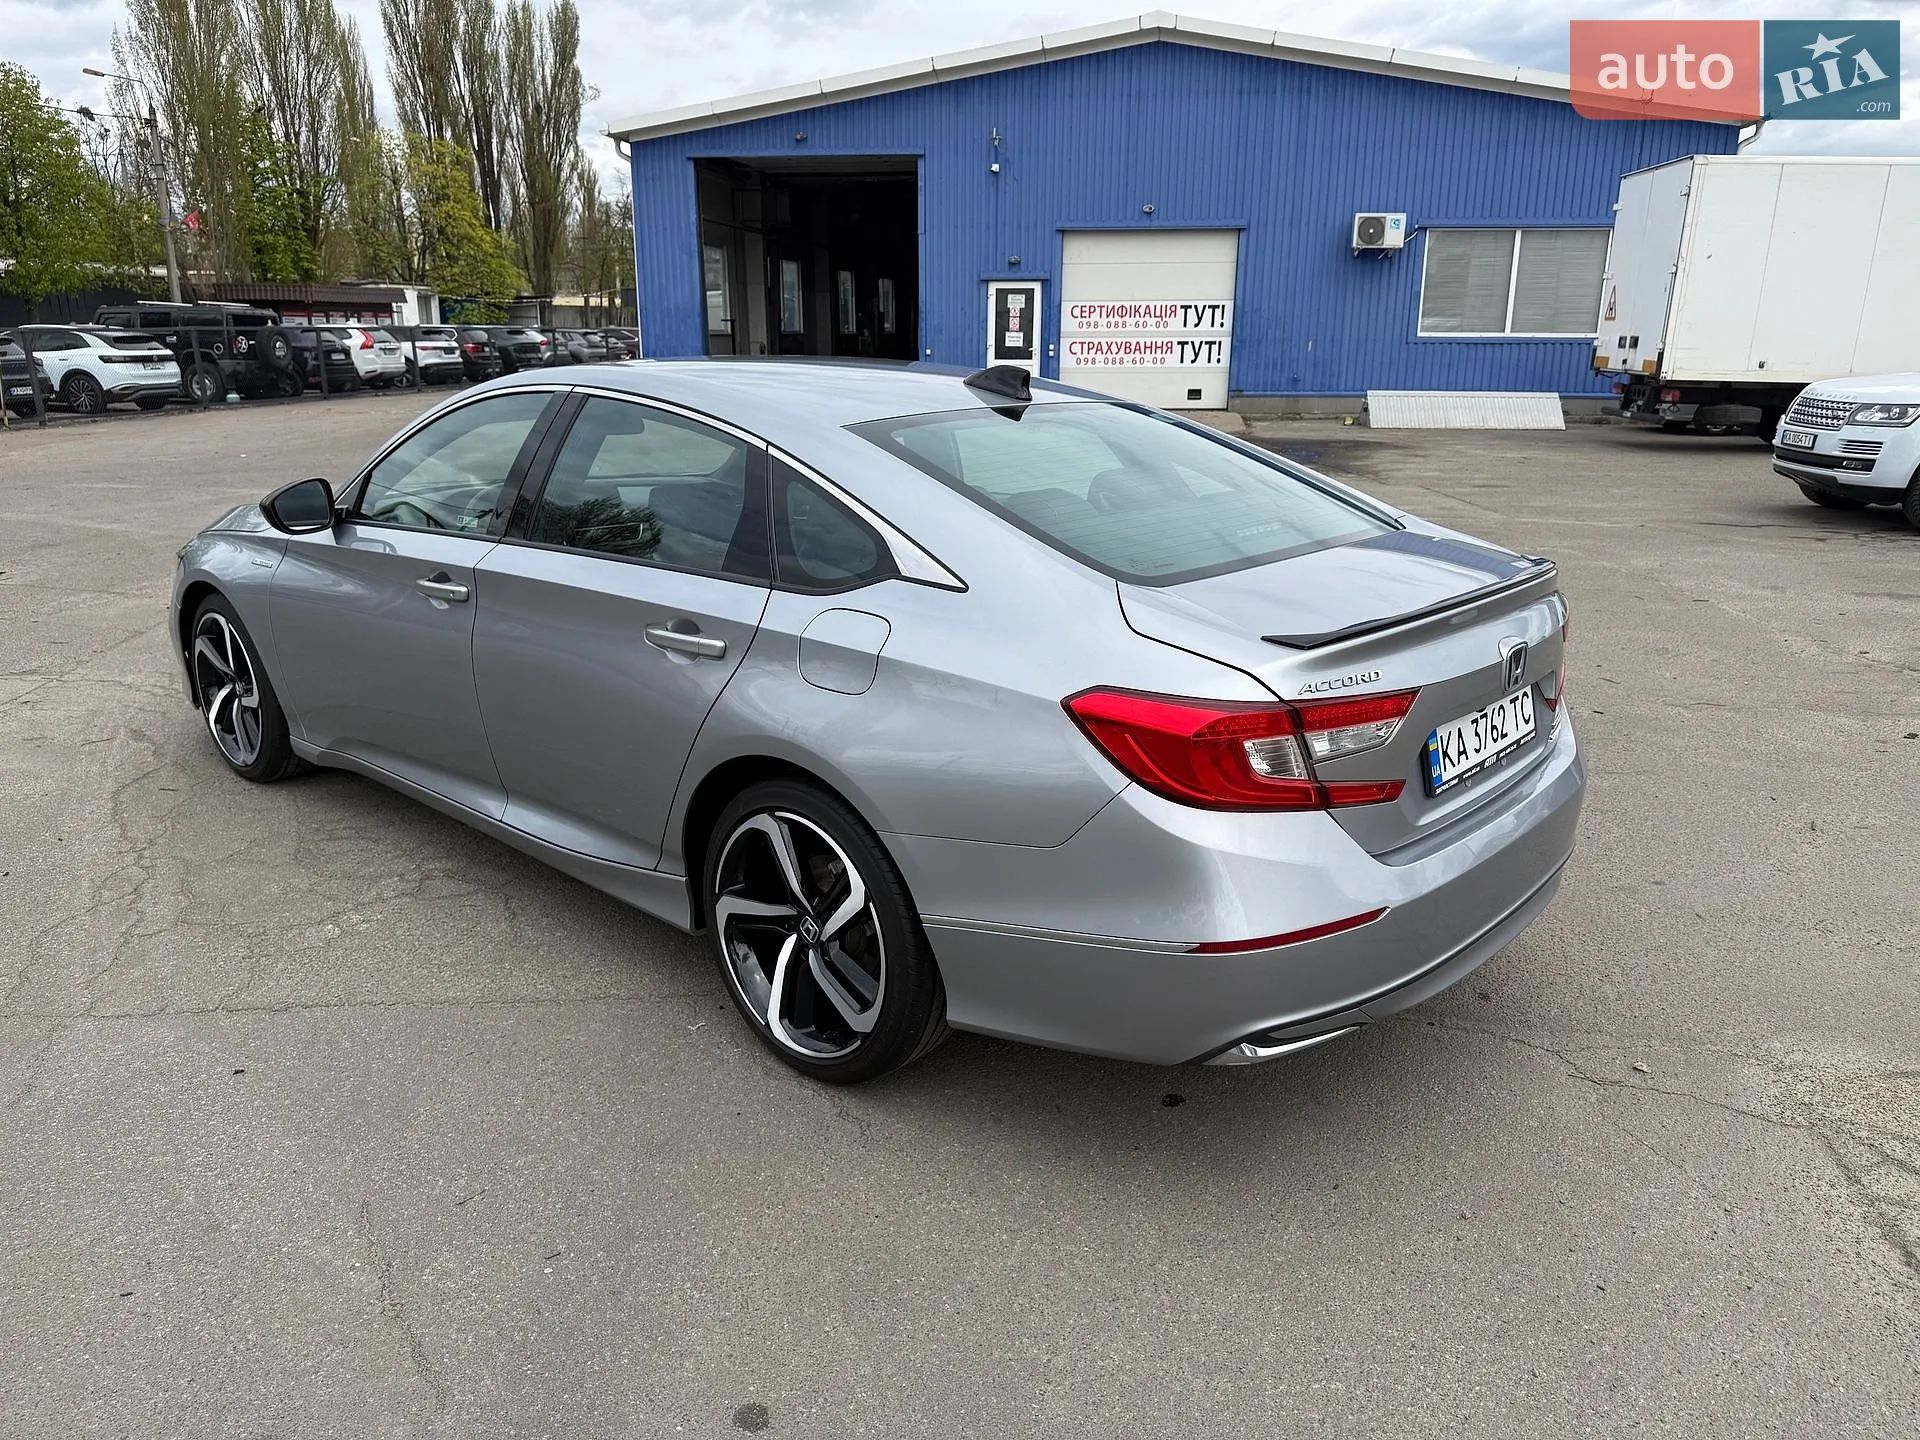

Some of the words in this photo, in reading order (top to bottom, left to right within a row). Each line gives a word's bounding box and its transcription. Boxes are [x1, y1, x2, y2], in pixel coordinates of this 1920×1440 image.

[1070, 304, 1177, 321] СЕРТИФІКАЦІЯ
[1180, 304, 1226, 328] ТУТ!
[1078, 320, 1169, 329] 098-088-60-00
[1069, 341, 1173, 355] СТРАХУВАННЯ
[1177, 341, 1222, 364] ТУТ!
[1075, 357, 1166, 365] 098-088-60-00
[1298, 670, 1383, 695] ACCORD
[1440, 727, 1469, 772] KA
[1471, 704, 1508, 753] 3762
[1510, 690, 1531, 731] TC
